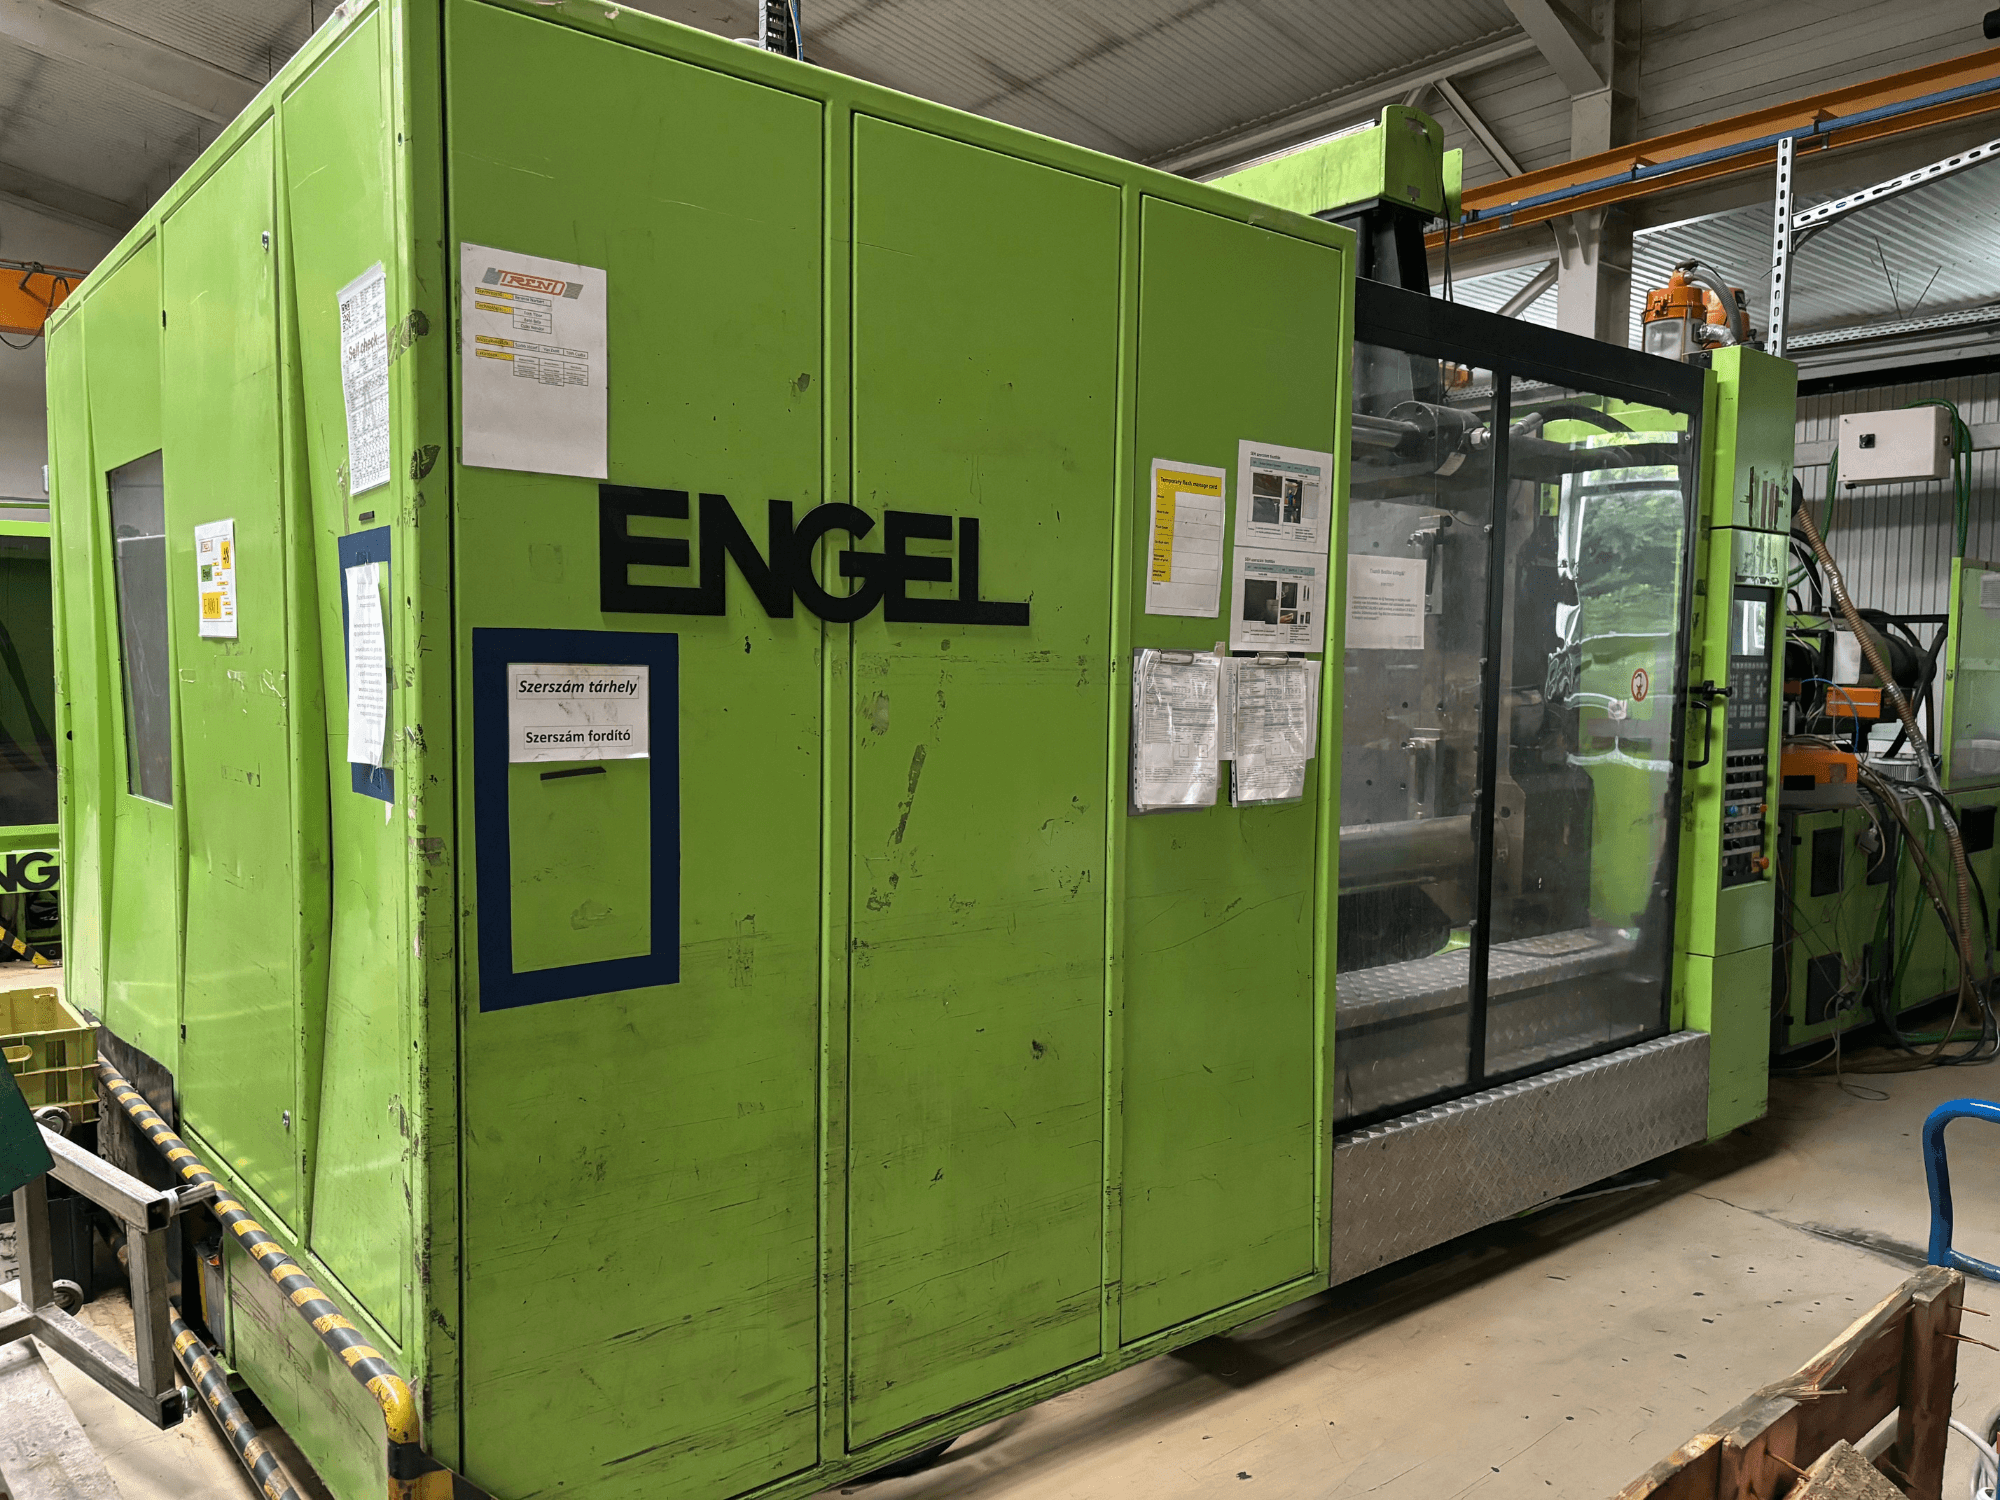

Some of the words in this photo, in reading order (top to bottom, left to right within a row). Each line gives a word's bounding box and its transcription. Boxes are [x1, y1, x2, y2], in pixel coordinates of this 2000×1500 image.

[497, 269, 567, 296] TREND
[1160, 476, 1182, 486] Temporary
[599, 483, 1030, 626] ENGEL
[518, 680, 584, 693] Szerszám
[588, 680, 638, 696] tárhely
[525, 730, 585, 743] Szerszám
[587, 729, 631, 742] fordító
